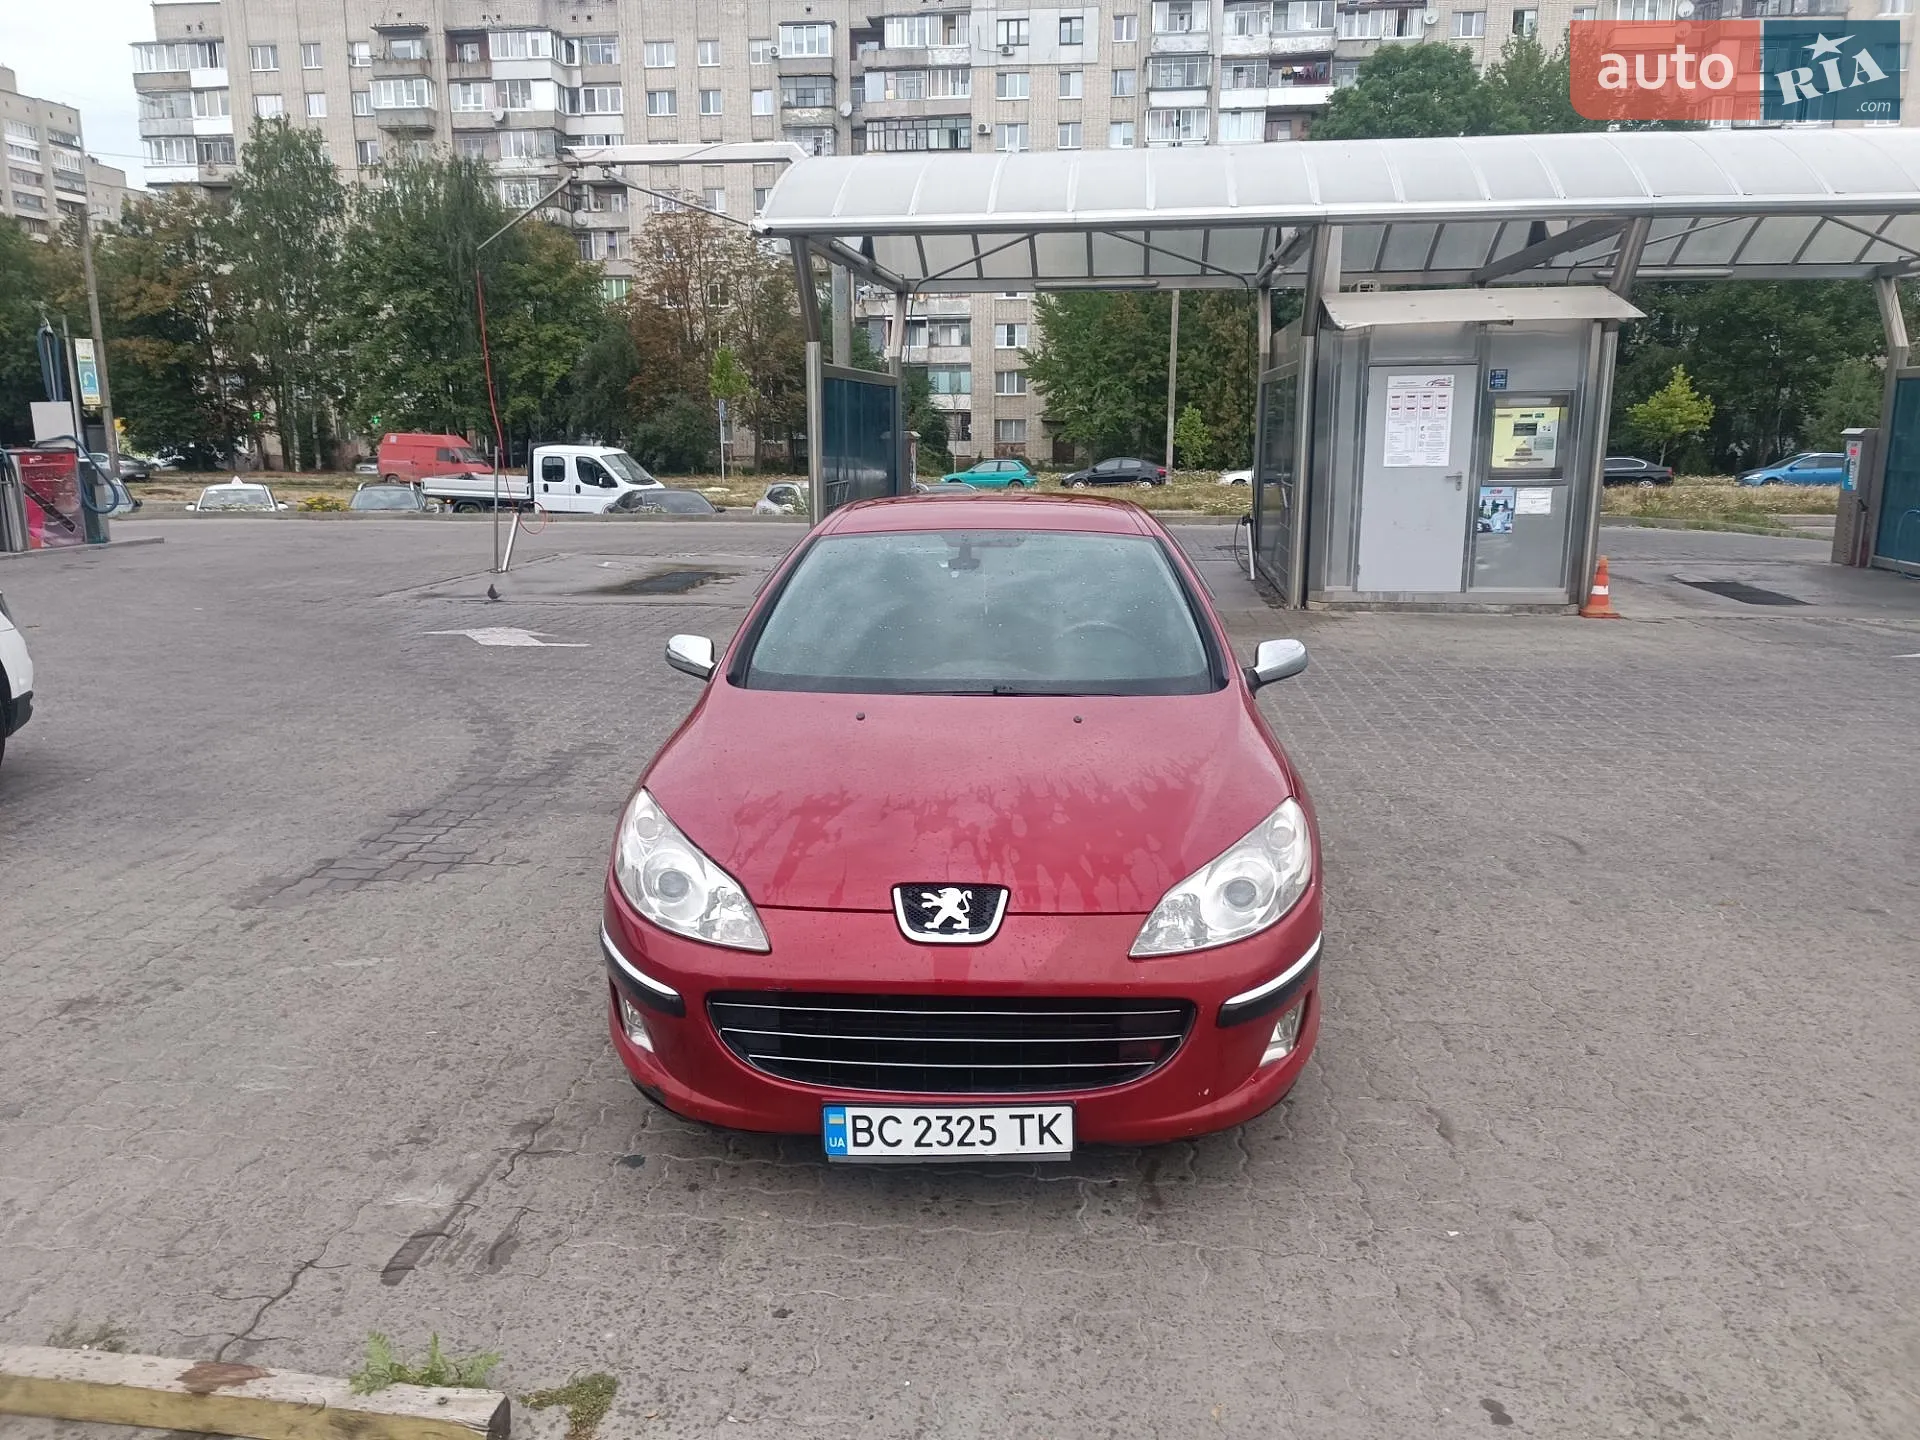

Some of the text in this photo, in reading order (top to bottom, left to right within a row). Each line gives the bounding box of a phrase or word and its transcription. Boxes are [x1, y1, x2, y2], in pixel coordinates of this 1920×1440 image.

[851, 1113, 1063, 1148] BC 2325 TK
[829, 1138, 845, 1148] UA
